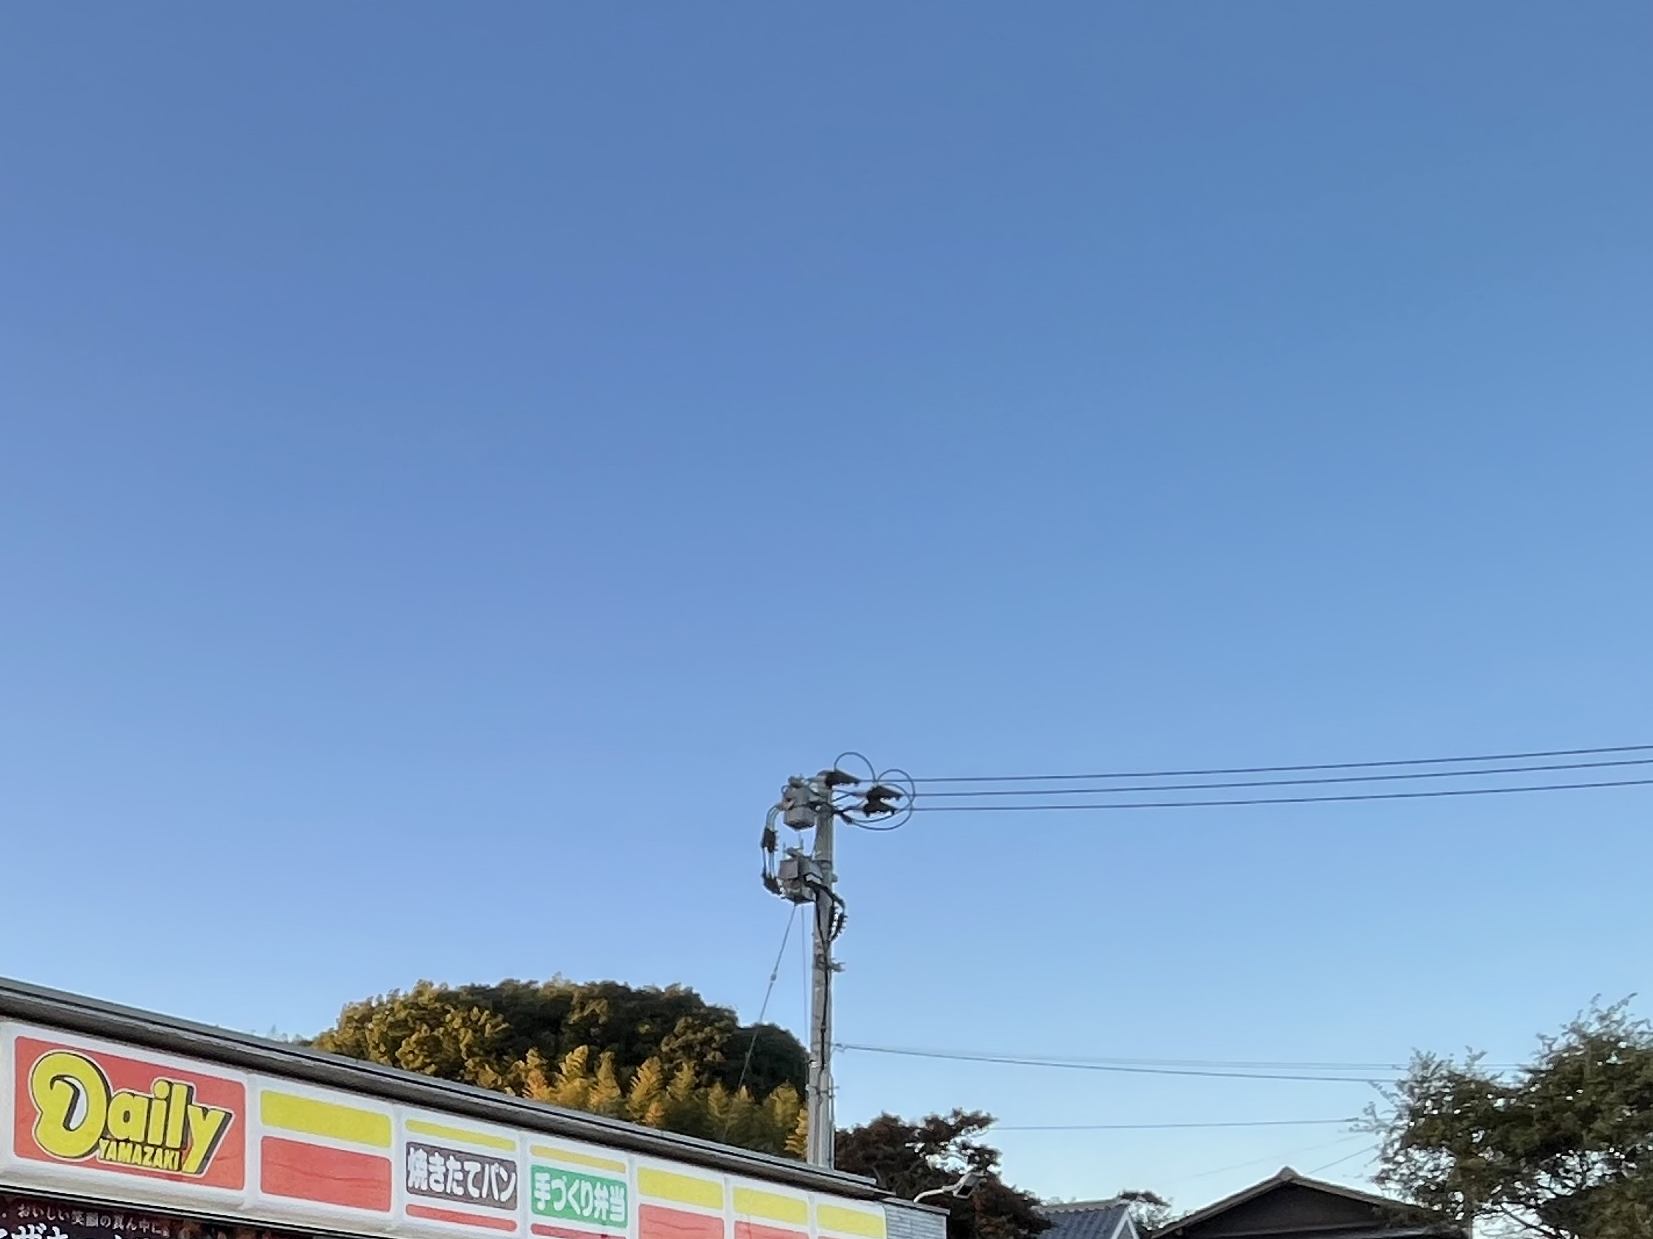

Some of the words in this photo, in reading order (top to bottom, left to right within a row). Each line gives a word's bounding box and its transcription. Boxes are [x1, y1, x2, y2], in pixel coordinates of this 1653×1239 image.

[32, 1051, 232, 1174] Daily
[98, 1137, 181, 1171] YAMAZAKI
[407, 1147, 517, 1202] 焼きたてパン
[534, 1171, 626, 1223] 手づくり弁当
